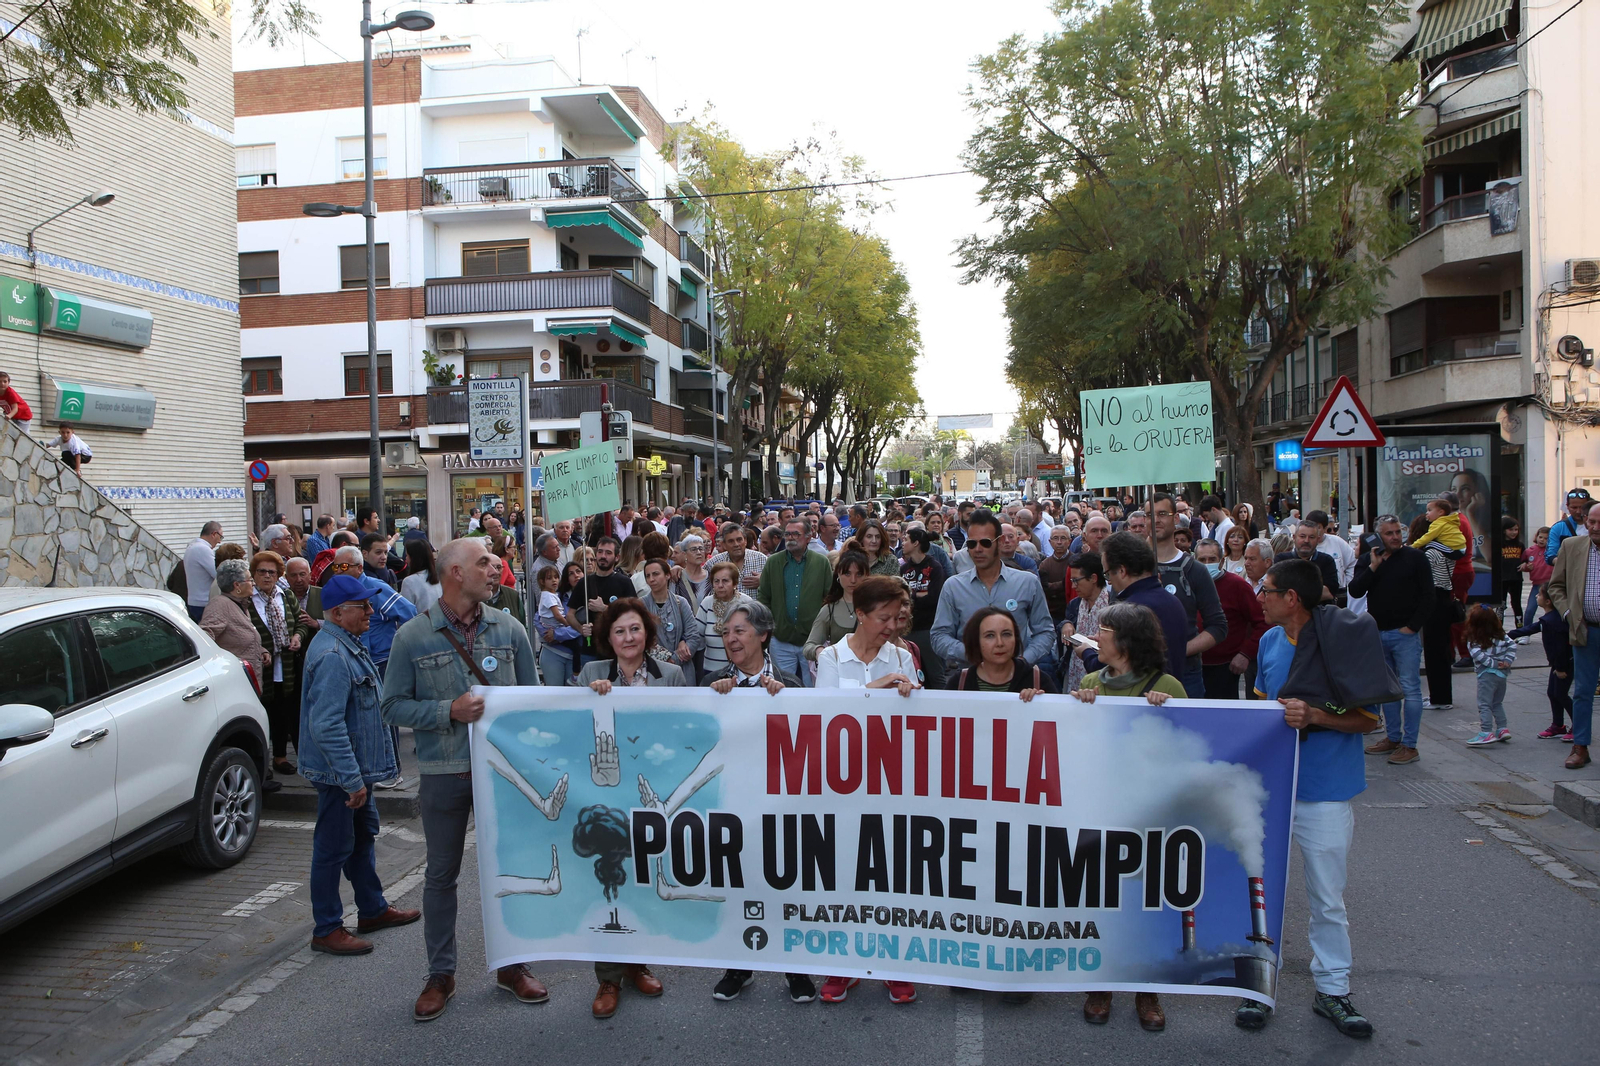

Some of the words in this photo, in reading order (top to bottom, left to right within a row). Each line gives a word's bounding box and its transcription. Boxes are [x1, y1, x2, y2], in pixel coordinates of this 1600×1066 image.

[8, 315, 32, 326] Urgencias
[473, 381, 515, 390] MONTILLA
[95, 401, 113, 412] Equipo
[114, 403, 121, 412] de
[121, 403, 135, 413] Salud
[136, 405, 152, 415] Mental
[475, 401, 515, 409] COMERCIAL
[1085, 396, 1122, 429] NO
[1132, 394, 1154, 423] al
[1161, 395, 1209, 419] humo
[1086, 438, 1102, 455] de
[1109, 433, 1128, 453] la
[1134, 426, 1213, 452] ORUJERA
[1383, 443, 1484, 460] Manhattan
[545, 460, 570, 483] AIRE
[576, 452, 609, 471] LIMPIO
[1402, 458, 1465, 475] School
[547, 488, 568, 504] PARA
[571, 472, 617, 498] MONTILLA
[766, 713, 1062, 807] MONTILLA
[632, 811, 744, 888] POR
[762, 813, 836, 891] UN
[855, 813, 977, 901] AIRE
[995, 820, 1202, 909] LIMPIO
[783, 903, 946, 931] PLATAFORMA
[950, 912, 1101, 940] CIUDADANA
[783, 928, 848, 956] POR
[854, 932, 900, 960] UN
[904, 936, 980, 968] AIRE
[986, 944, 1102, 972] LIMPIO
